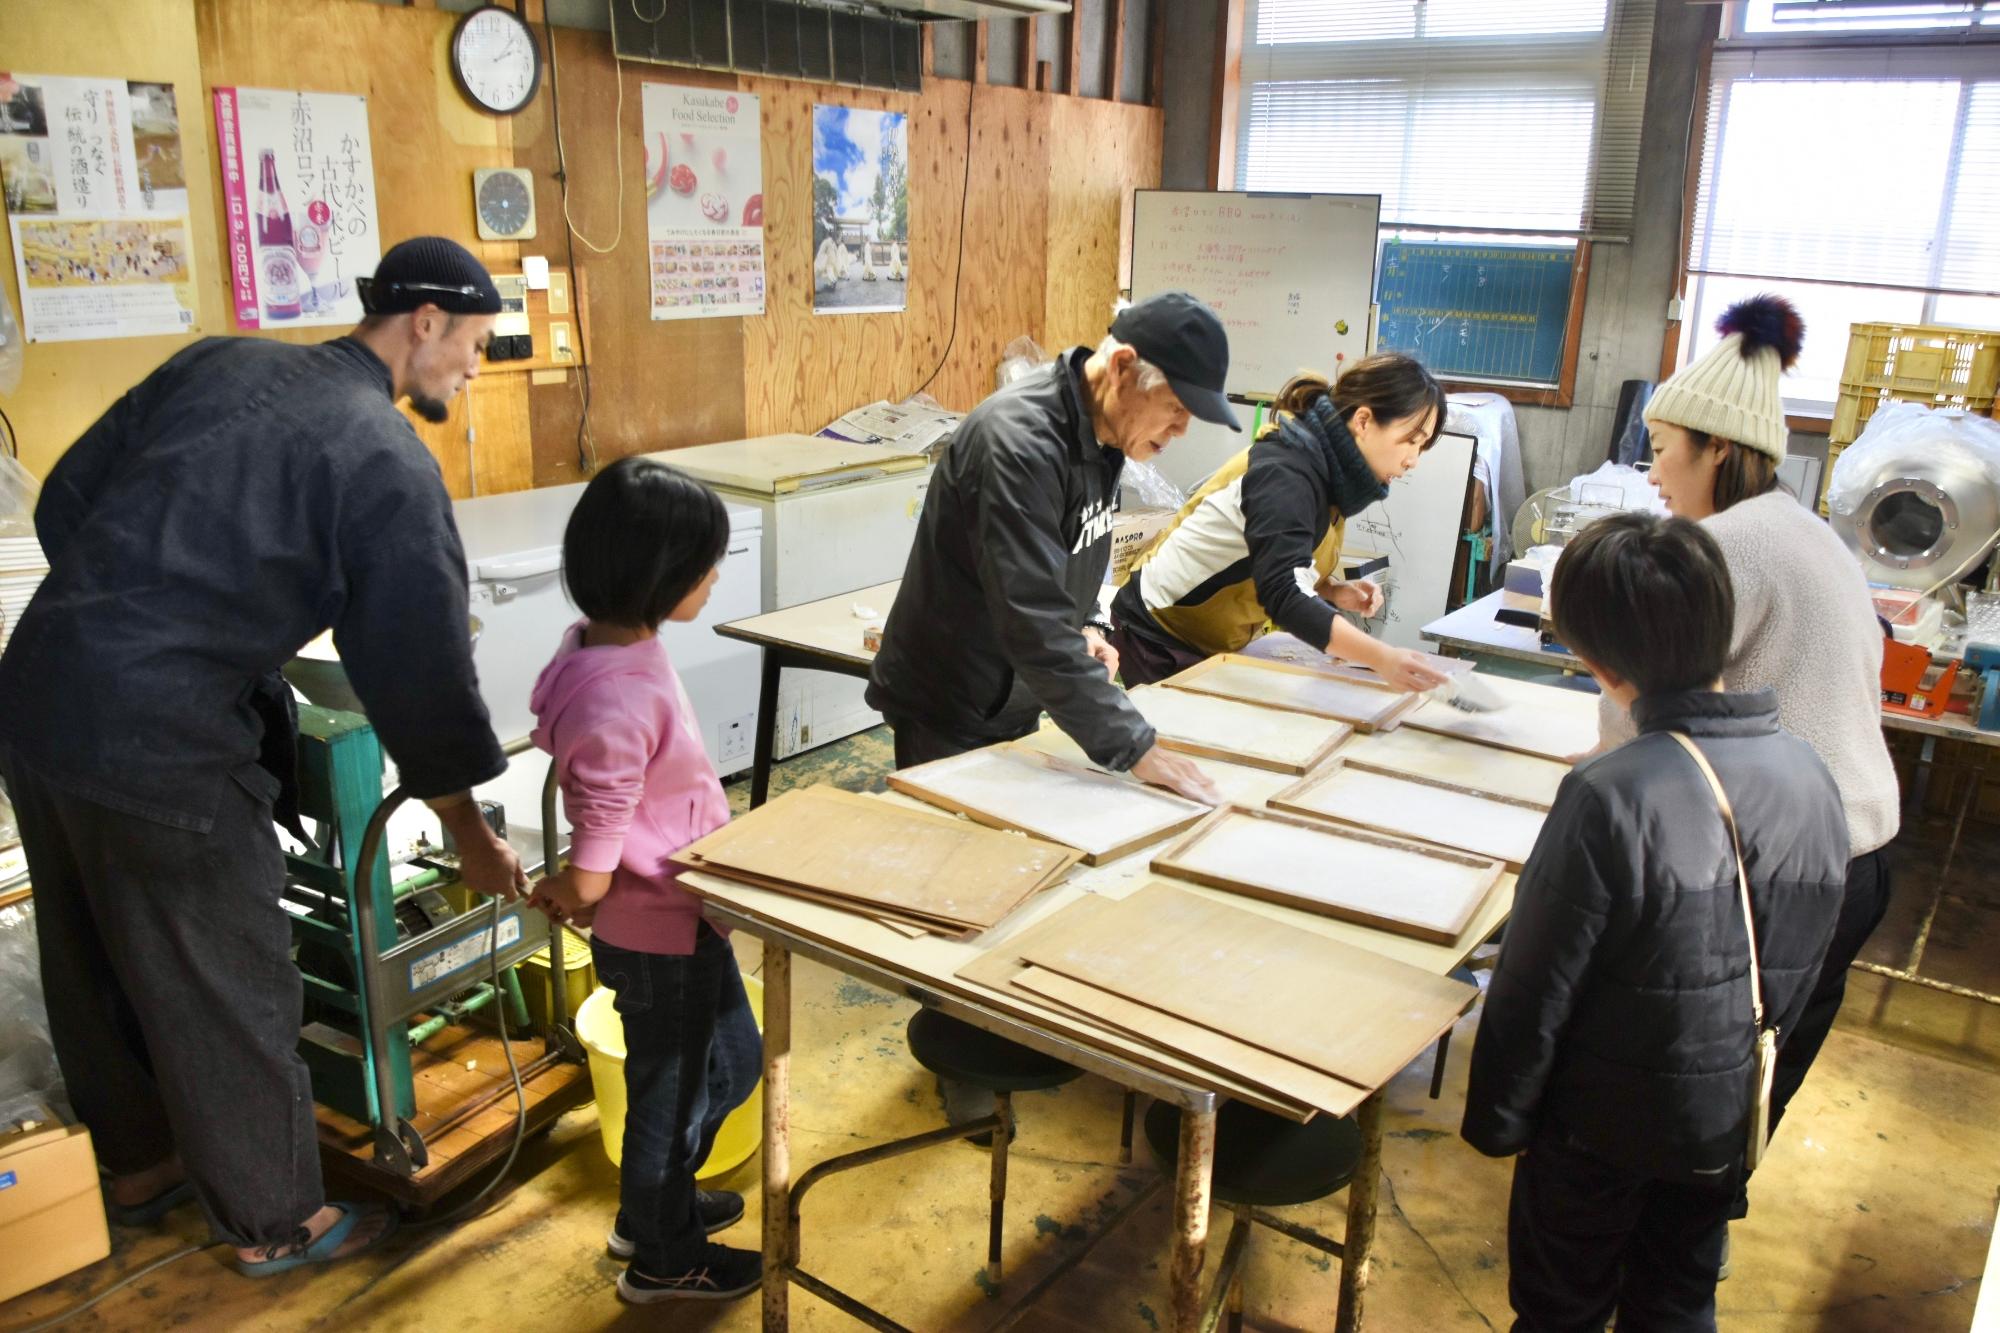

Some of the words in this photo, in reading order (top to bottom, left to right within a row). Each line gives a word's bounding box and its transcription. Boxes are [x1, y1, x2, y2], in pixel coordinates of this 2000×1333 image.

[682, 93, 725, 109] Kasukabe
[672, 107, 694, 121] Food
[695, 110, 736, 126] Selection
[341, 132, 367, 237] かすかべの
